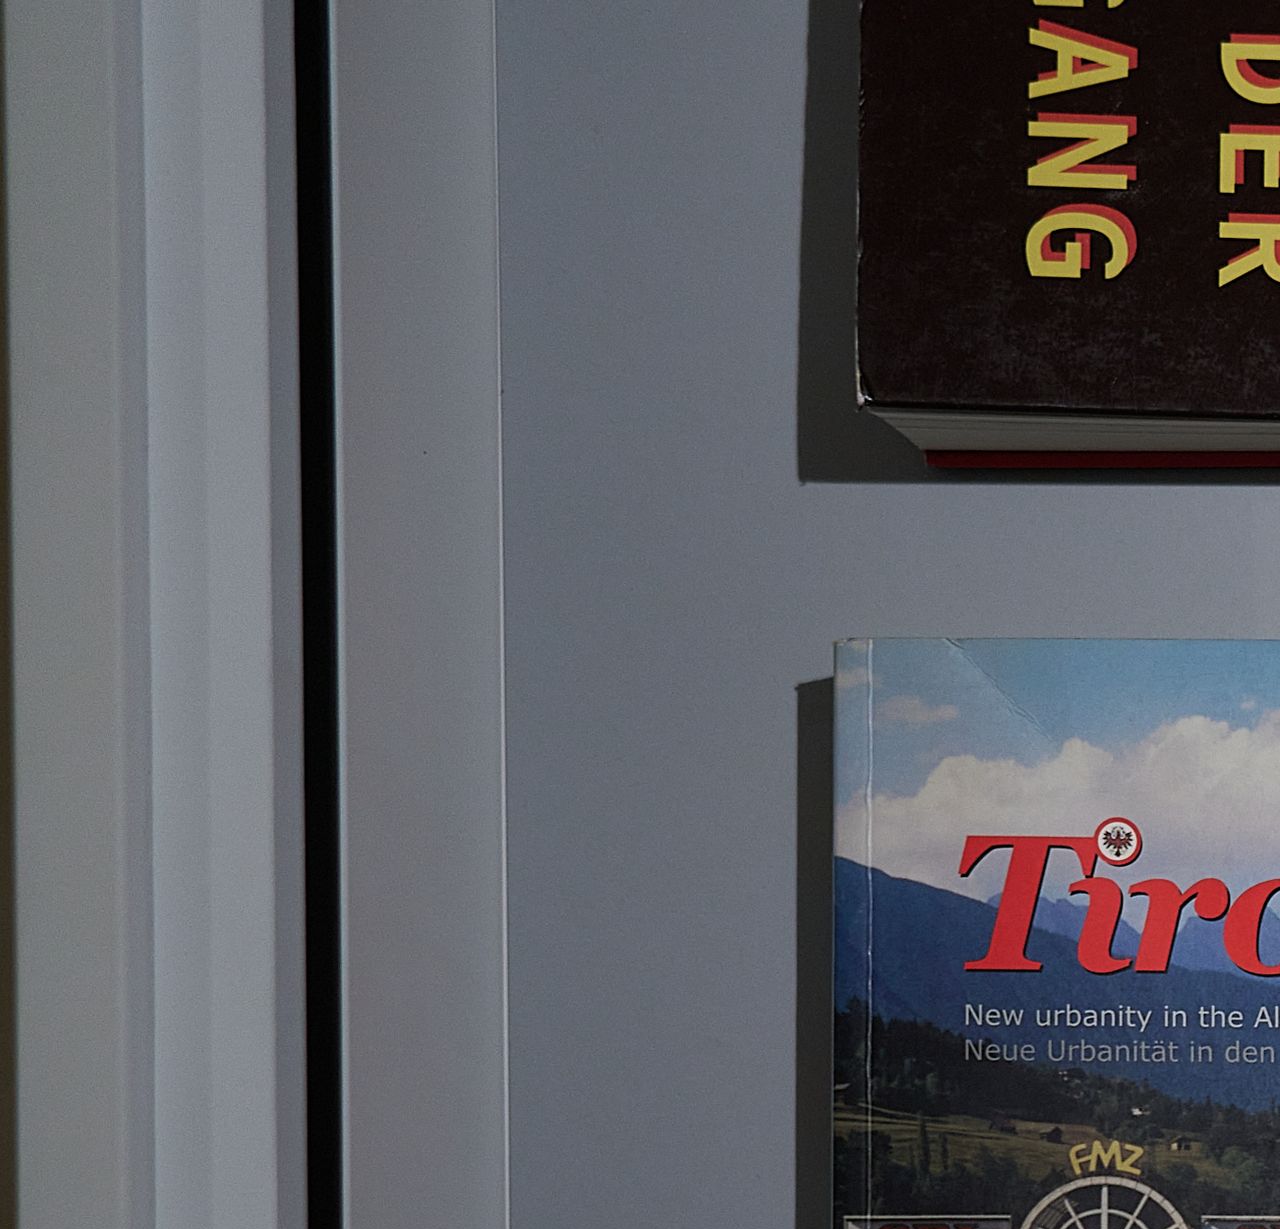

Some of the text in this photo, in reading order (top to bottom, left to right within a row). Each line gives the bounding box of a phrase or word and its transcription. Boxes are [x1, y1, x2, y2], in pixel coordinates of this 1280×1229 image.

[1025, 0, 1138, 280] ANG
[963, 1003, 1025, 1028] New
[1035, 1003, 1153, 1033] urbanity
[1164, 1004, 1188, 1029] in
[1198, 1004, 1244, 1029] the
[963, 1039, 1036, 1063] Neue
[1046, 1037, 1181, 1064] Urbanität
[1190, 1040, 1214, 1064] in
[1224, 1040, 1276, 1065] den
[1068, 1140, 1146, 1176] FMZ
